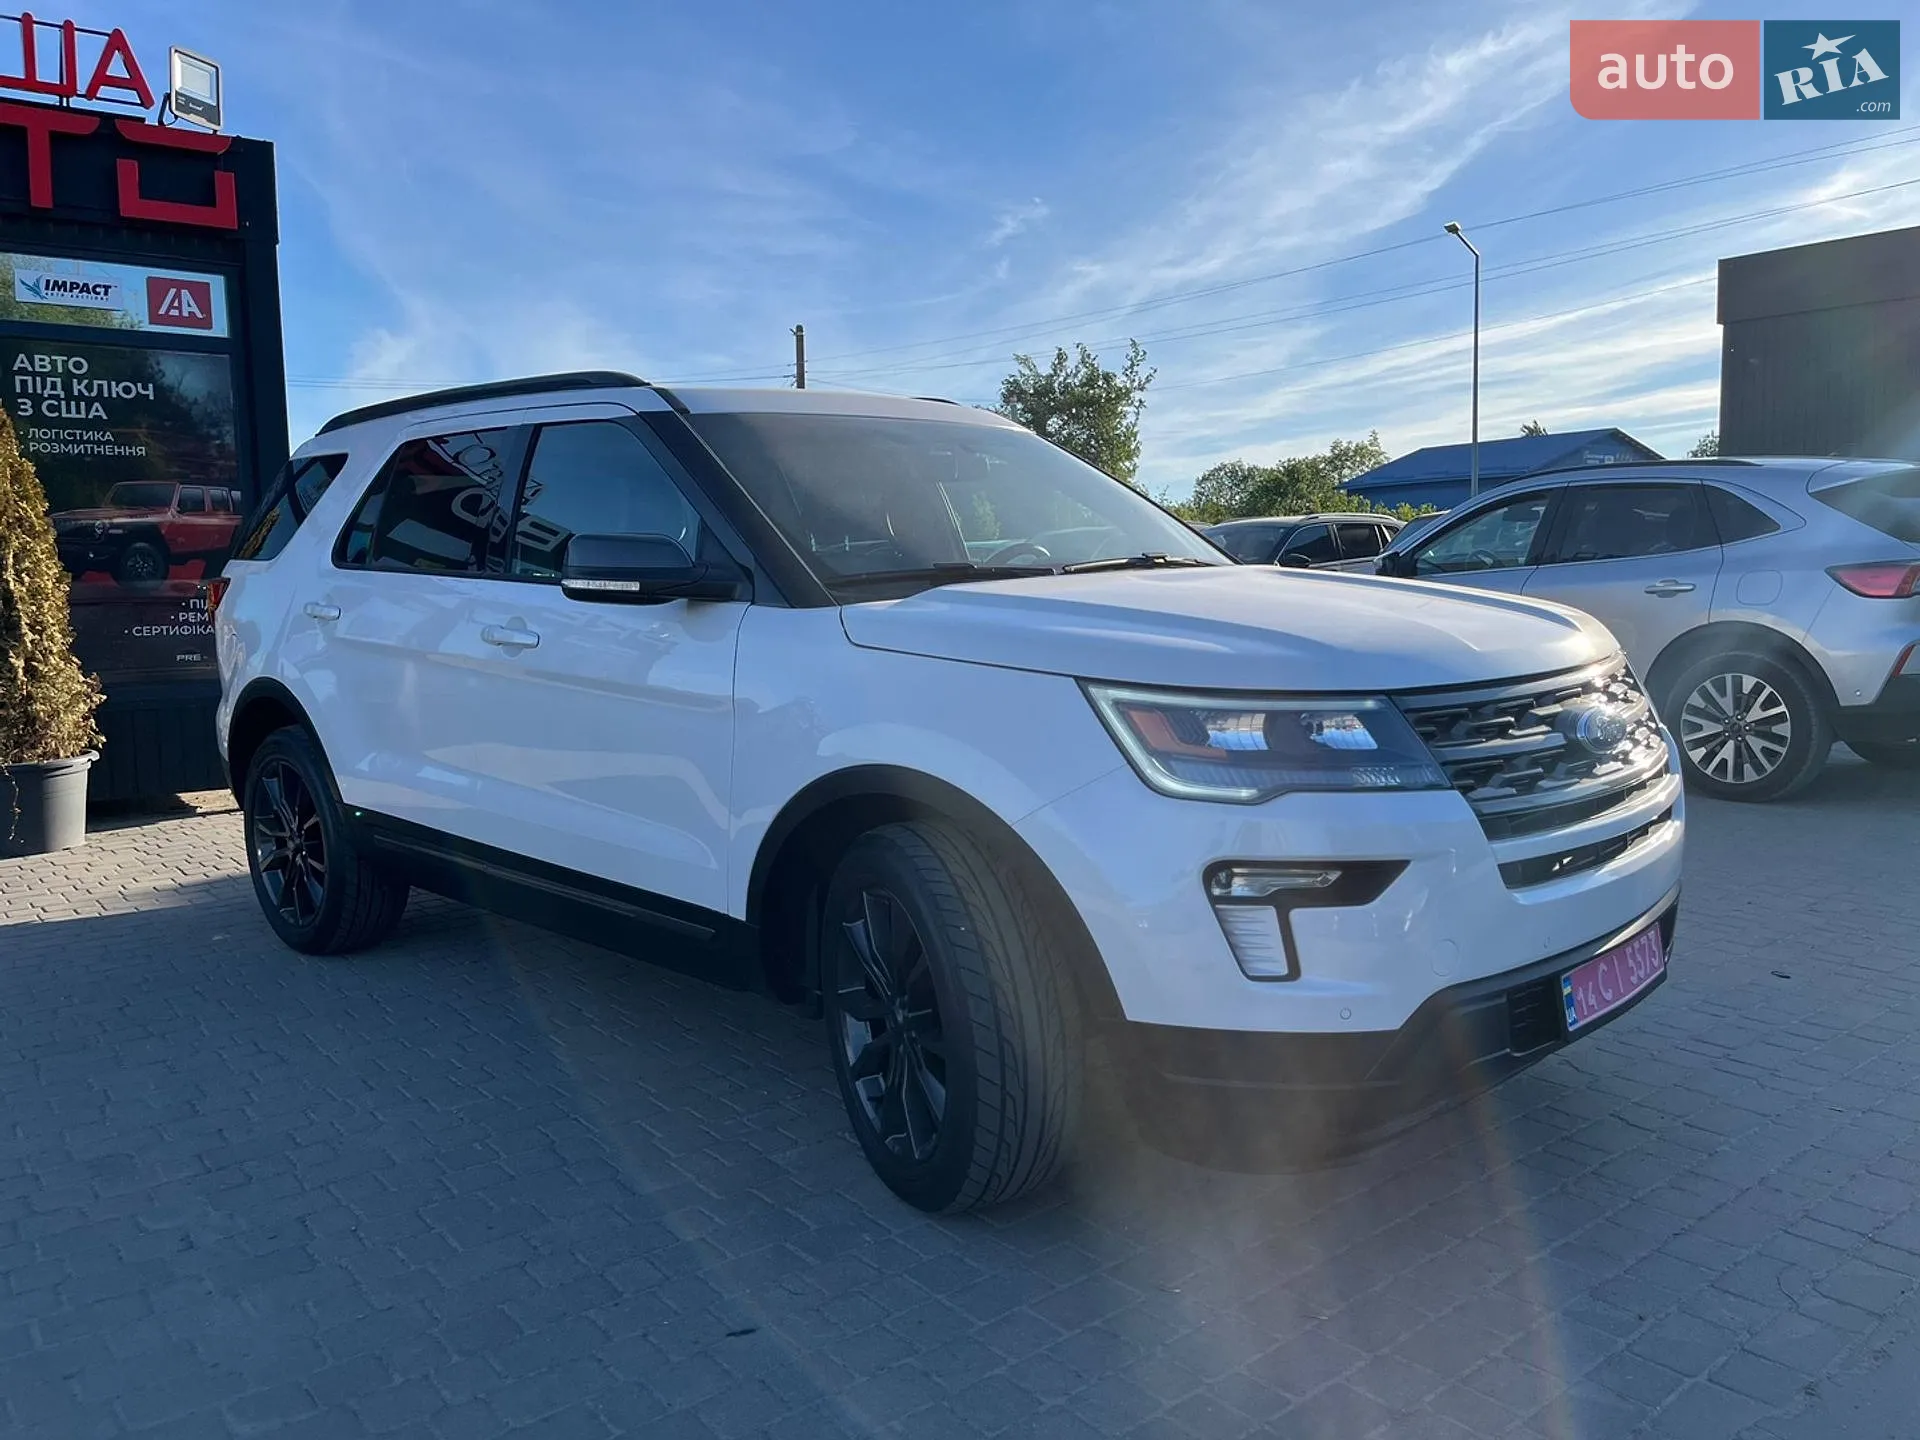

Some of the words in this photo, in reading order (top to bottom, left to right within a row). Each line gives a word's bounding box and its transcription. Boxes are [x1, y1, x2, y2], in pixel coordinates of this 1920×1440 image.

[44, 279, 112, 296] IMPACT
[12, 353, 89, 375] АВТО
[14, 375, 65, 399] ПІД
[72, 379, 155, 400] КЛЮЧ
[17, 398, 33, 416] З
[41, 400, 108, 420] США
[28, 428, 114, 442] ЛОГІСТИКА
[29, 442, 147, 457] РОЗМИТНЕННЯ
[178, 612, 209, 623] РЕМ
[132, 625, 214, 636] СЕРТИФІКА
